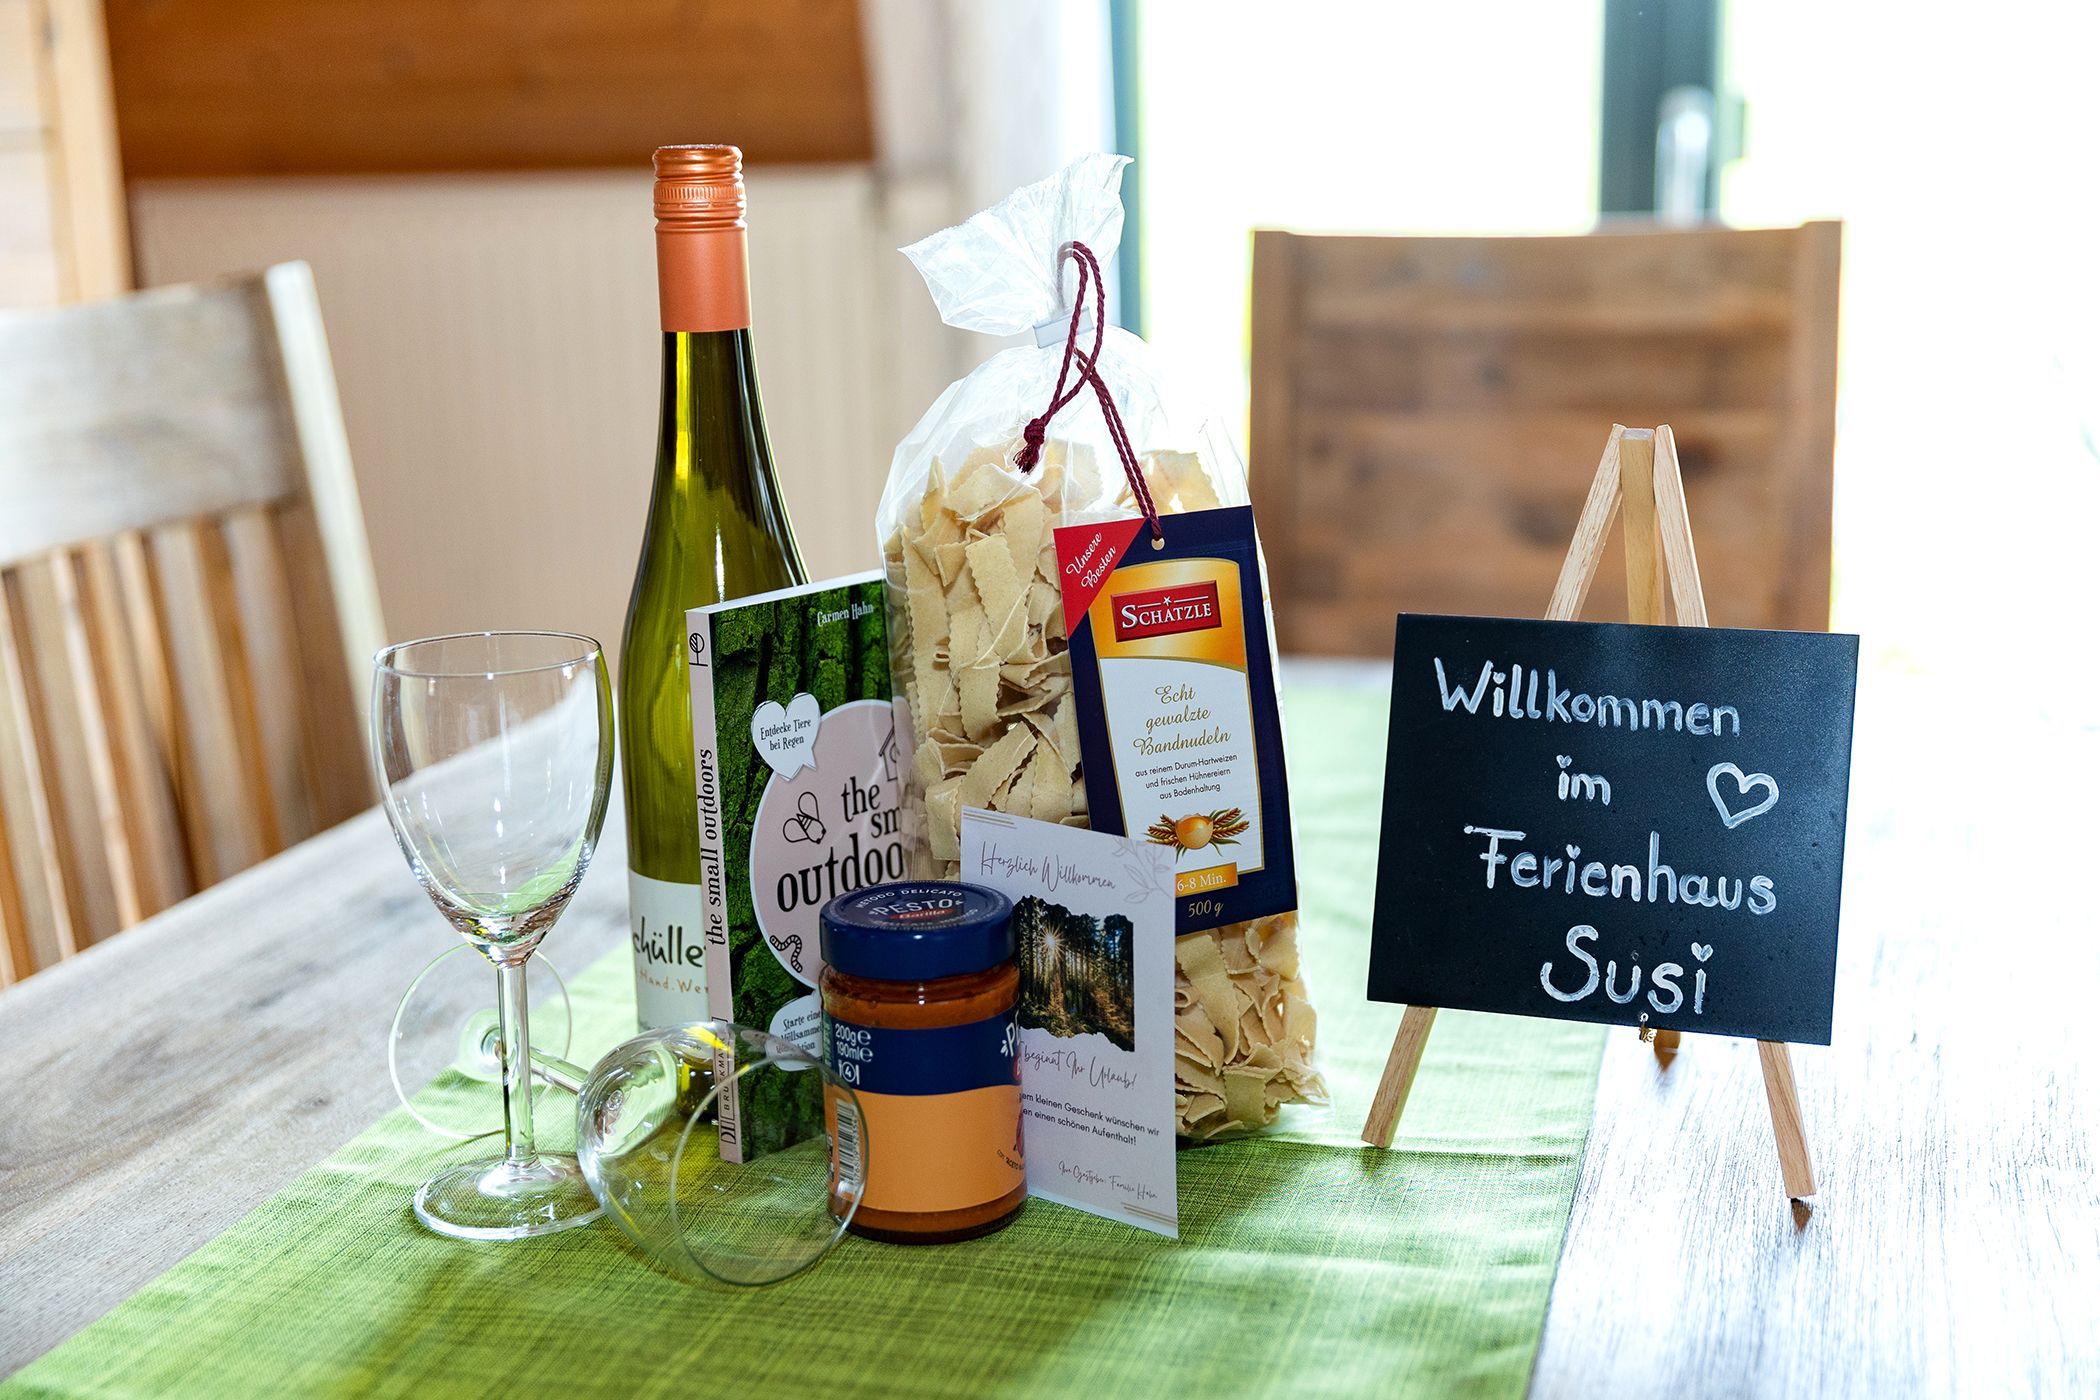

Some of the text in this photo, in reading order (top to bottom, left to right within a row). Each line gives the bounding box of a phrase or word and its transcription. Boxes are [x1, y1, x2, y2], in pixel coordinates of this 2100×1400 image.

[1066, 532, 1102, 574] Unsere
[1081, 546, 1116, 588] Besten
[817, 601, 874, 627] Carmen Hahn
[1154, 683, 1196, 705] Echt
[1434, 657, 1741, 736] Willkommen
[760, 718, 812, 741] Entdecke Tiere
[1145, 704, 1211, 734] gewalzte
[769, 734, 805, 751] bei Regen
[1132, 726, 1231, 756] Bandnudeln
[1135, 754, 1238, 778] aus reinem Durum-Hartweizen
[1145, 768, 1231, 789] und frischen Hühnereiern
[1556, 755, 1611, 805] im
[841, 776, 881, 823] the
[1159, 783, 1221, 800] aus Bodenhaltung
[697, 749, 726, 946] the small outdoors
[981, 841, 1116, 892] Herzlich Willkommen
[1464, 824, 1777, 915] Ferienhaus
[1177, 873, 1227, 892] 6-8 Min.
[855, 889, 962, 908] METODO DELICATO
[873, 898, 952, 916] PESTO
[1188, 900, 1224, 918] 500 g
[633, 916, 705, 968] chülle
[1540, 924, 1714, 1014] Susi
[783, 1015, 804, 1031] Starte
[1024, 1045, 1066, 1072] beginnt
[1089, 1056, 1137, 1090] Urlaub!
[1035, 1093, 1062, 1110] kleinen
[1064, 1102, 1103, 1121] Geschenk
[1105, 1116, 1145, 1133] wünschen
[1147, 1127, 1160, 1137] wir
[1035, 1110, 1056, 1123] einen
[1058, 1117, 1090, 1133] schönen
[1092, 1125, 1137, 1146] Aufenthalt!
